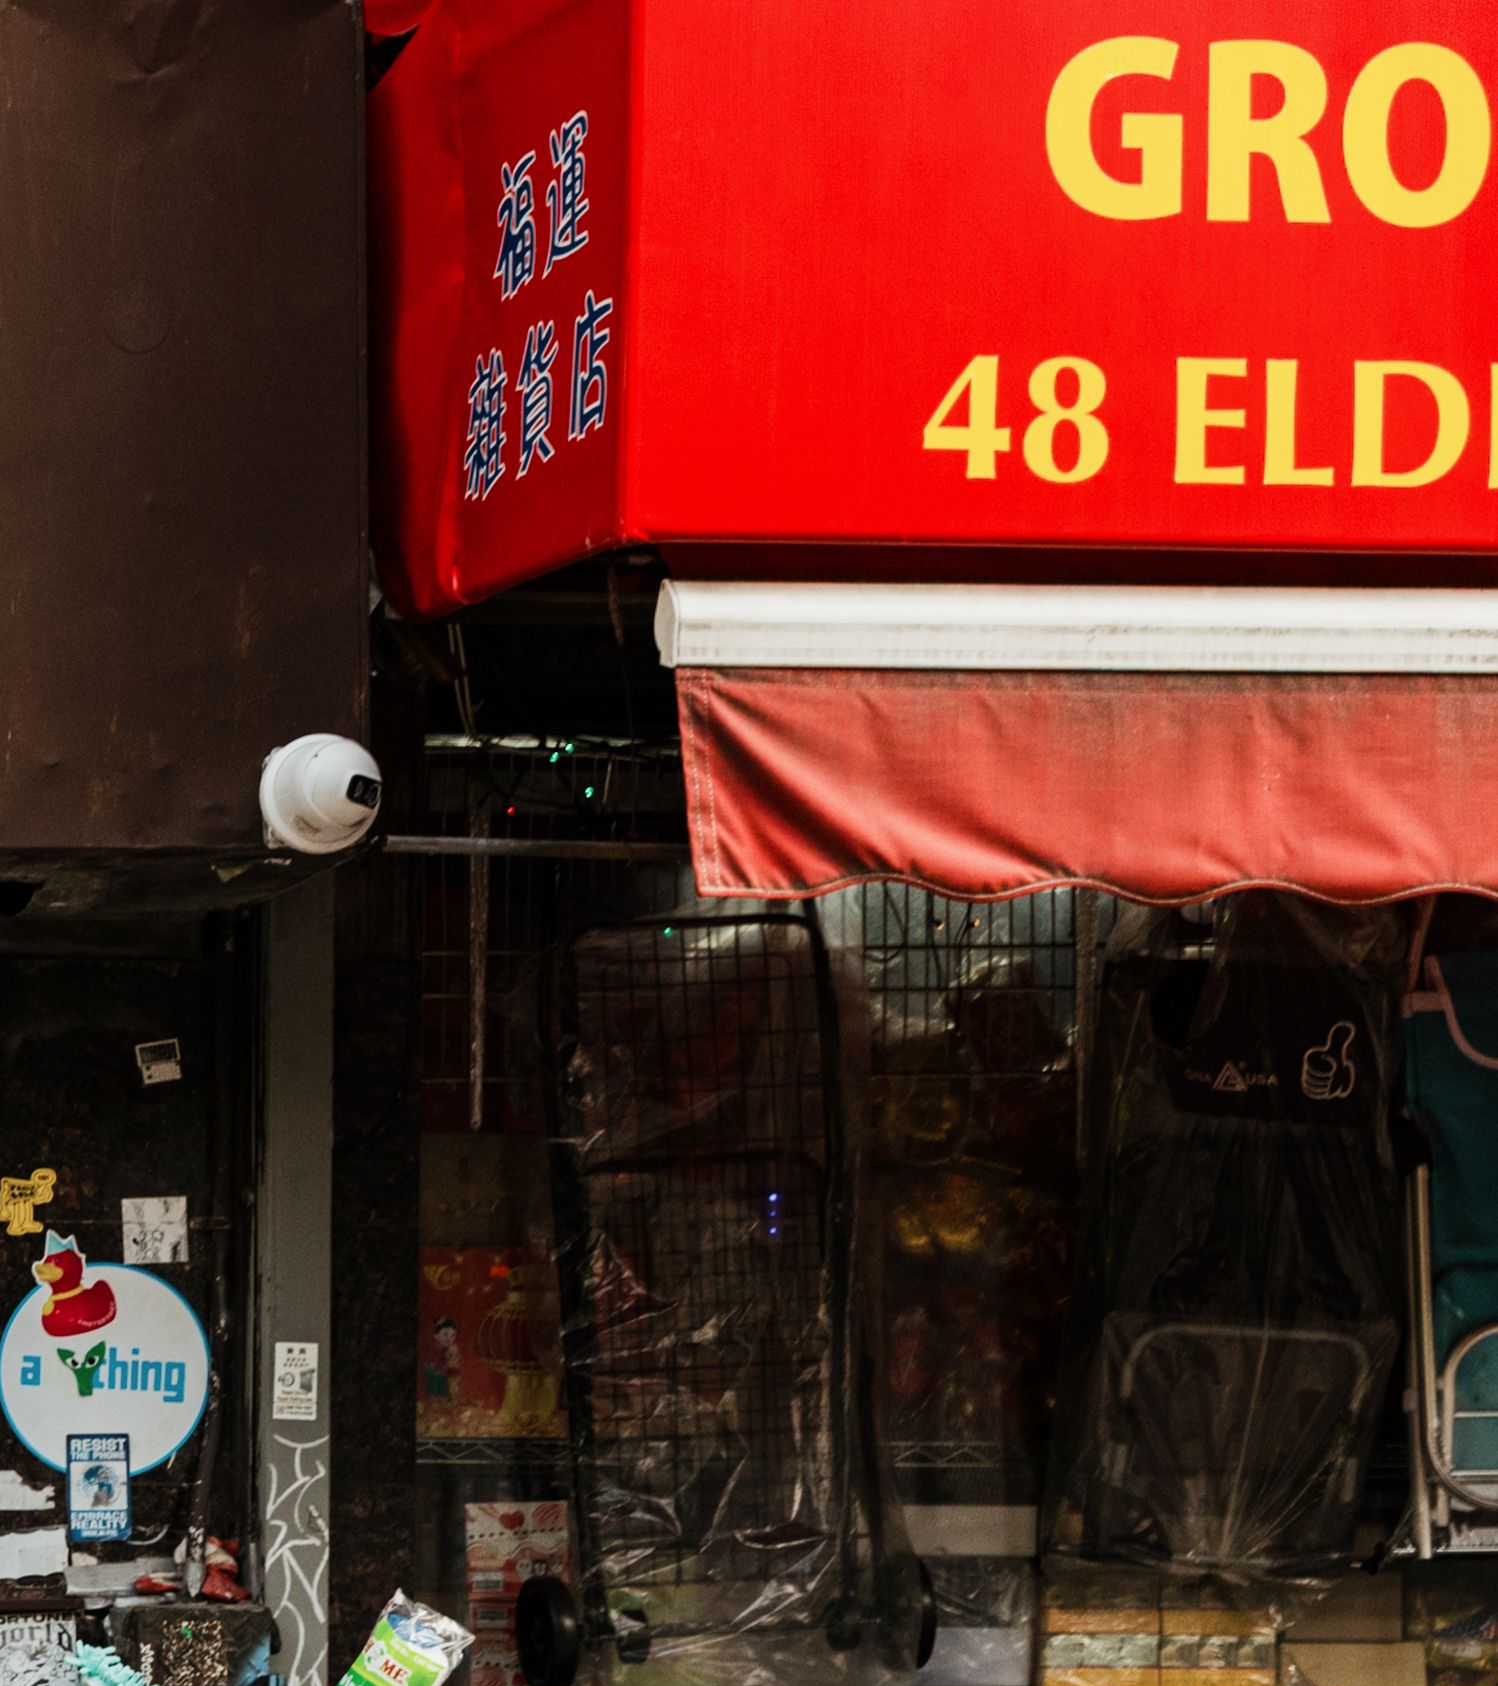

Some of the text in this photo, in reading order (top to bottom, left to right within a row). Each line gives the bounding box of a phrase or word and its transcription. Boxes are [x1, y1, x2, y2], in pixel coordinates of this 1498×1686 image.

[1045, 34, 1492, 229] GRO
[493, 108, 591, 300] 福運
[463, 289, 616, 502] 雜貨店
[922, 354, 1498, 488] 48 ELD
[70, 1438, 127, 1451] RESIST
[70, 1511, 128, 1521] EMBRACE
[70, 1519, 128, 1530] REALITY
